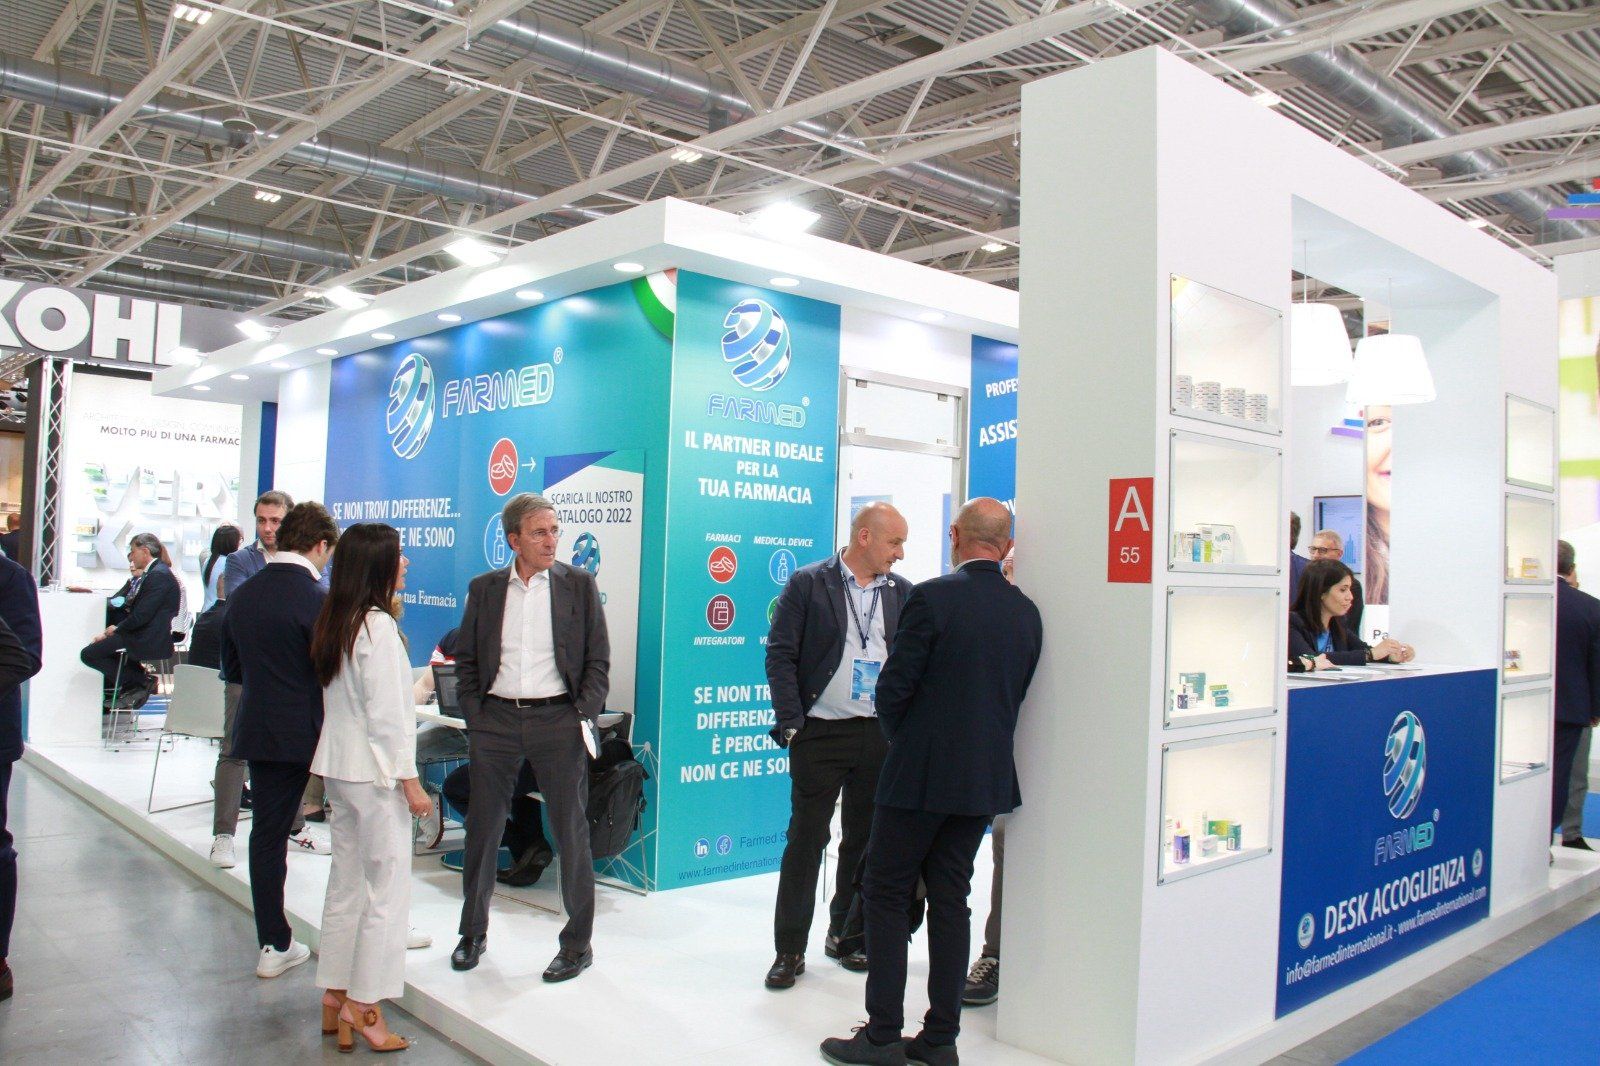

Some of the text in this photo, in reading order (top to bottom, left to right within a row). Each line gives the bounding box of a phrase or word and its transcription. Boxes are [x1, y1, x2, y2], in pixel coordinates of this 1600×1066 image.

[442, 362, 555, 419] FARMED
[985, 378, 1019, 398] PROFE
[707, 393, 807, 429] FARMED
[100, 425, 137, 437] MOLTO
[160, 431, 171, 440] DI
[174, 432, 196, 442] UNA
[979, 419, 1018, 448] ASSIS
[685, 430, 824, 463] IL PARTNER IDEALE
[736, 460, 779, 478] PER LA
[551, 490, 633, 505] SCARICA IL NOSTRO
[698, 477, 813, 505] TUA FARMACIA
[333, 502, 343, 519] SE
[344, 501, 363, 519] NON
[365, 500, 389, 519] TROVI
[555, 508, 632, 524] ATALOGO 2022
[1114, 486, 1150, 532] A
[409, 527, 423, 547] NE
[424, 527, 455, 547] SONO
[705, 532, 742, 543] FARMACI
[753, 535, 814, 548] MEDICAL DEVICE
[1120, 546, 1140, 564] 55
[403, 592, 417, 604] tua
[418, 590, 457, 608] Farmacia
[693, 636, 746, 646] INTEGRATORI
[694, 686, 713, 705] SE
[716, 684, 751, 703] NON
[696, 708, 777, 731] DIFFERENZ
[711, 733, 721, 755] È
[680, 763, 716, 784] NON
[720, 761, 739, 780] CE
[743, 759, 763, 778] NE
[740, 833, 777, 849] Farmed
[1374, 820, 1436, 867] FARMED
[1324, 856, 1466, 940] DESK ACCOGLIENZA
[1285, 924, 1393, 986] info@farmedinternational.it
